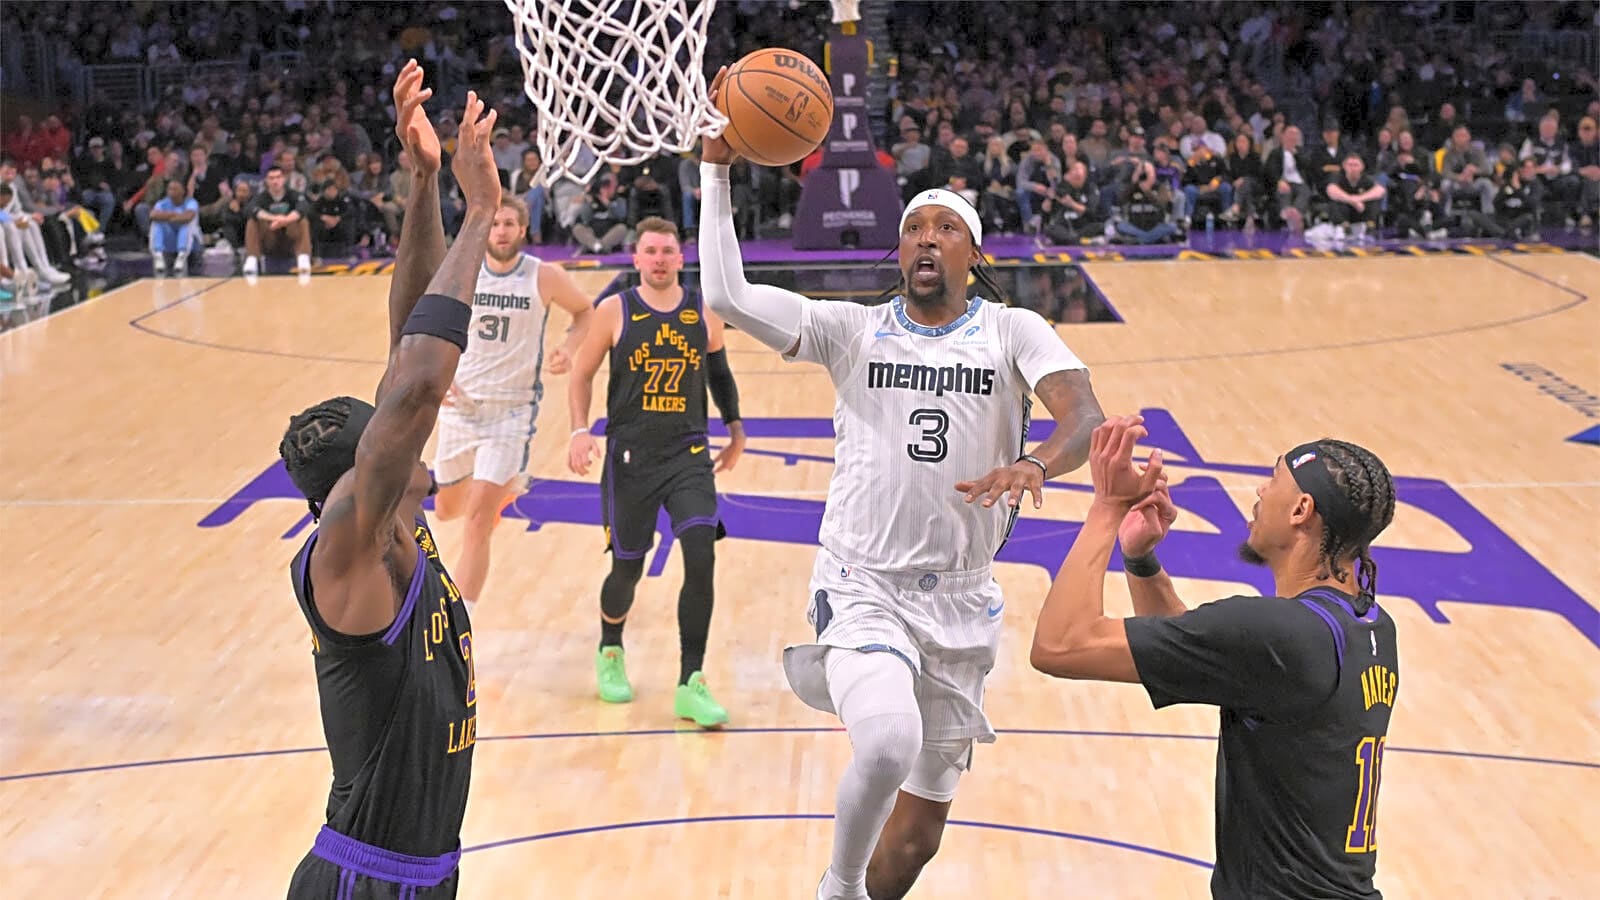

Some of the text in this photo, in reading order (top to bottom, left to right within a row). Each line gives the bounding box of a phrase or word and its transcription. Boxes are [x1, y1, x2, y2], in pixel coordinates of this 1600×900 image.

[773, 54, 832, 100] Wilson
[478, 314, 511, 343] 31
[628, 323, 702, 371] LOS ANGELES
[644, 358, 687, 393] 77
[868, 361, 996, 397] memphis
[642, 395, 687, 413] LAKERS
[907, 408, 950, 463] 3
[424, 597, 449, 661] LOS
[1361, 665, 1396, 711] HAYES
